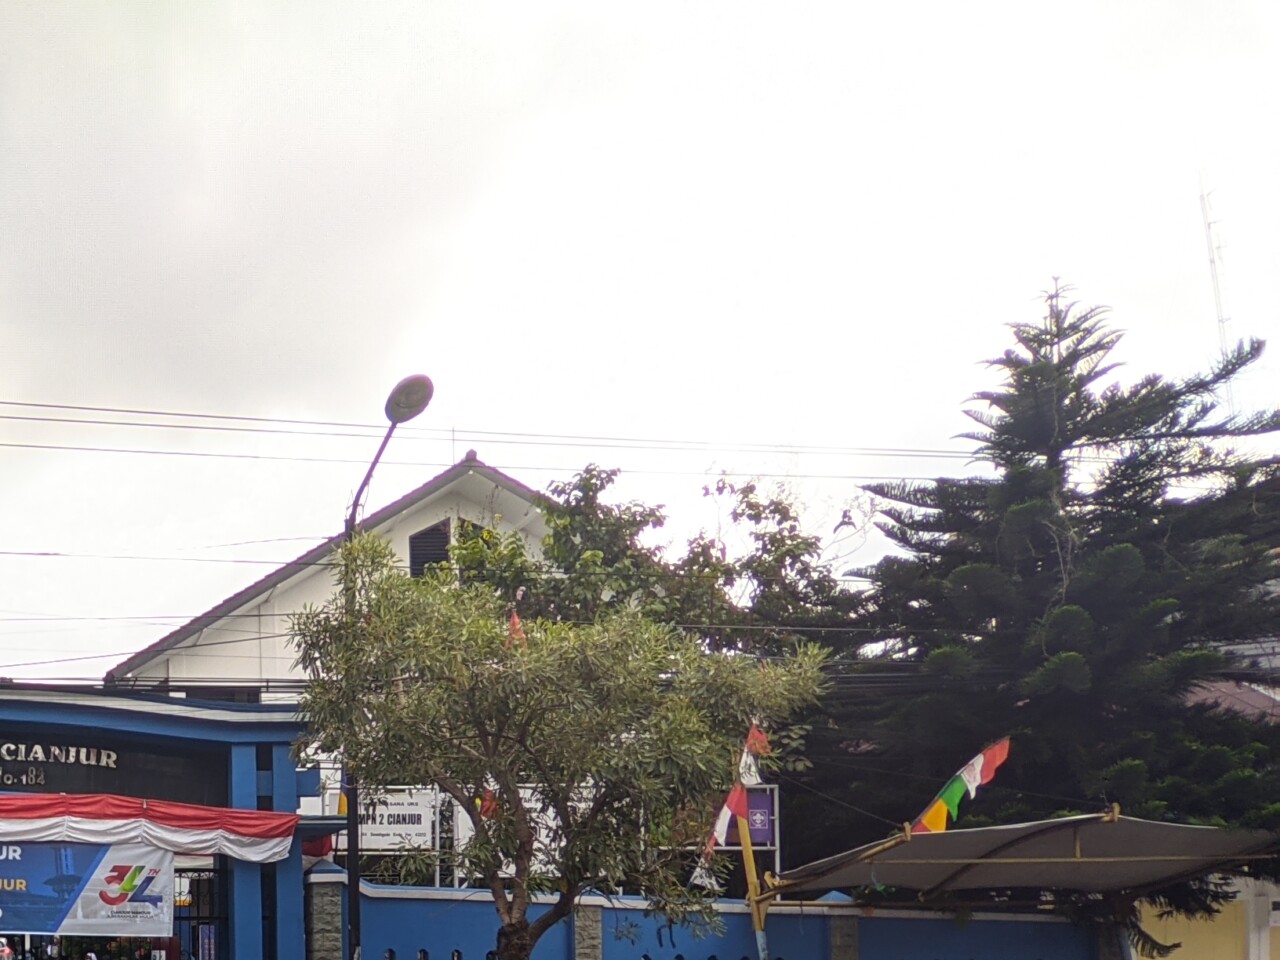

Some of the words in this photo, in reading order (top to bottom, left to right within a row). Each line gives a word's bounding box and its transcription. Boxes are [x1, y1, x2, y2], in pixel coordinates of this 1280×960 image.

[0, 743, 117, 768] CIANJUR
[358, 814, 377, 825] MPN
[379, 813, 385, 825] 2
[387, 813, 422, 825] CIANJUR
